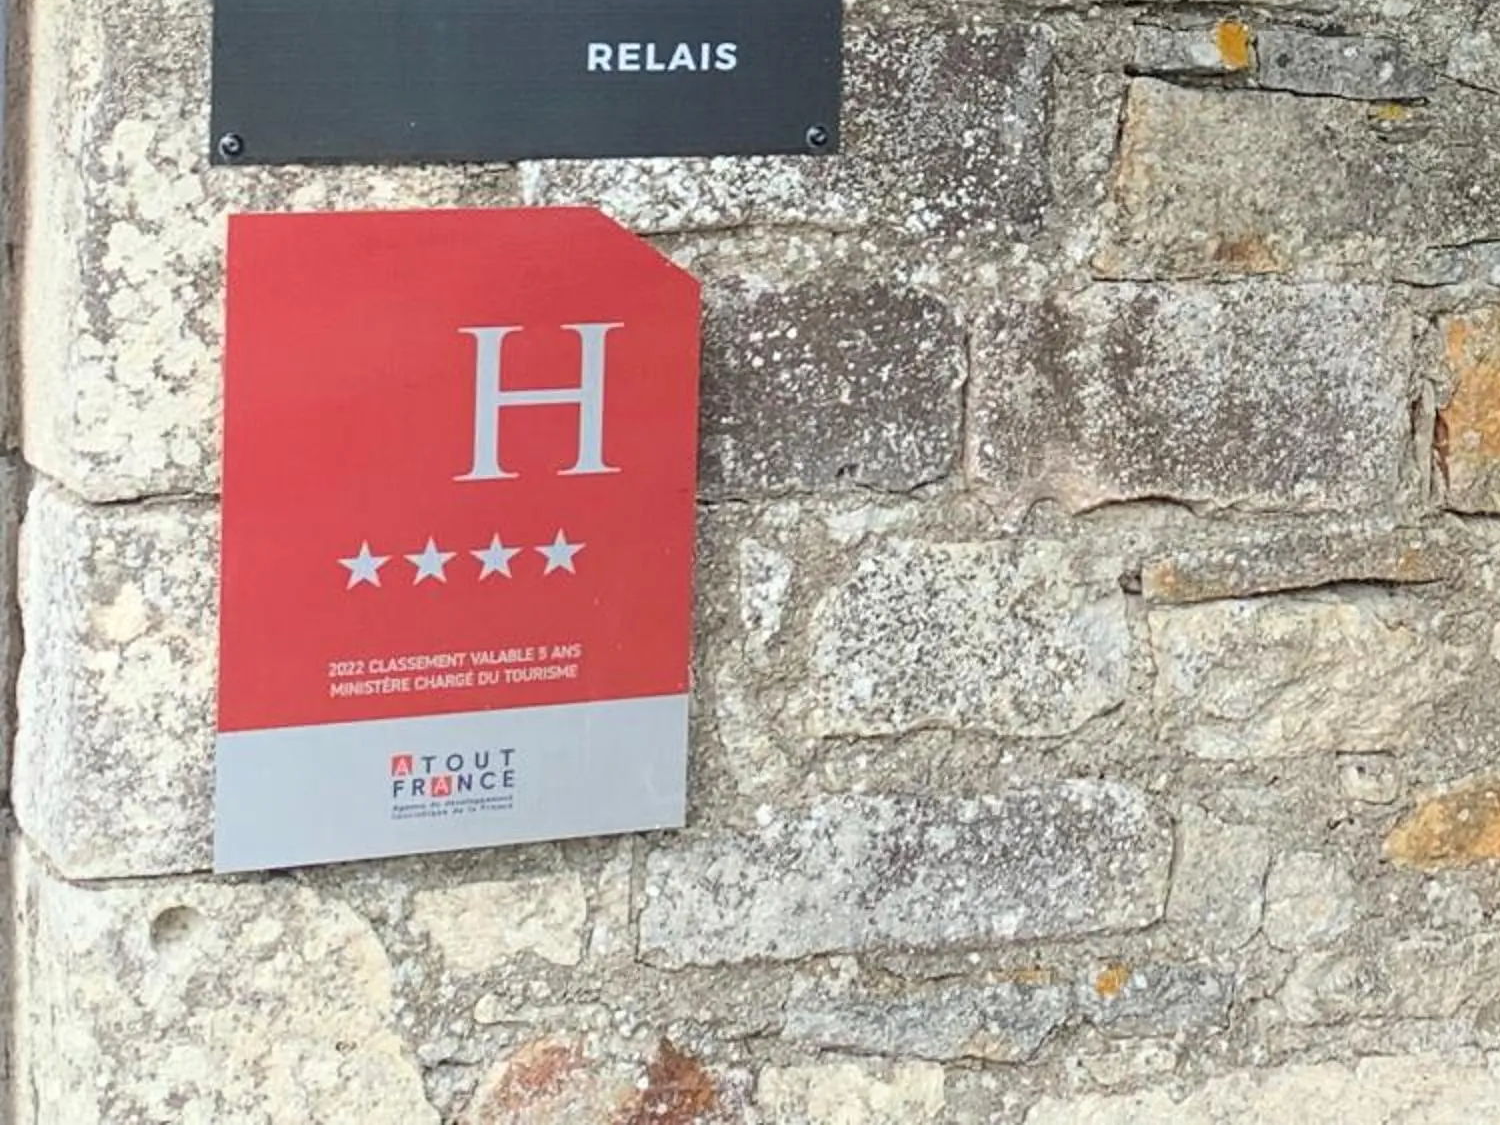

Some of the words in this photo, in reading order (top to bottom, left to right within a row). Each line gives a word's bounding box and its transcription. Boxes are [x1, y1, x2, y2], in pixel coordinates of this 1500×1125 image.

[587, 43, 738, 72] RELAIS
[453, 321, 626, 483] H
[328, 661, 367, 677] 2022
[368, 653, 467, 674] CLASSEMENT
[470, 647, 535, 665] VALABLE
[537, 646, 549, 659] 5
[551, 644, 582, 658] ANS
[478, 670, 500, 685] DU
[504, 664, 578, 683] TOURISME
[393, 769, 515, 798] FRANCE
